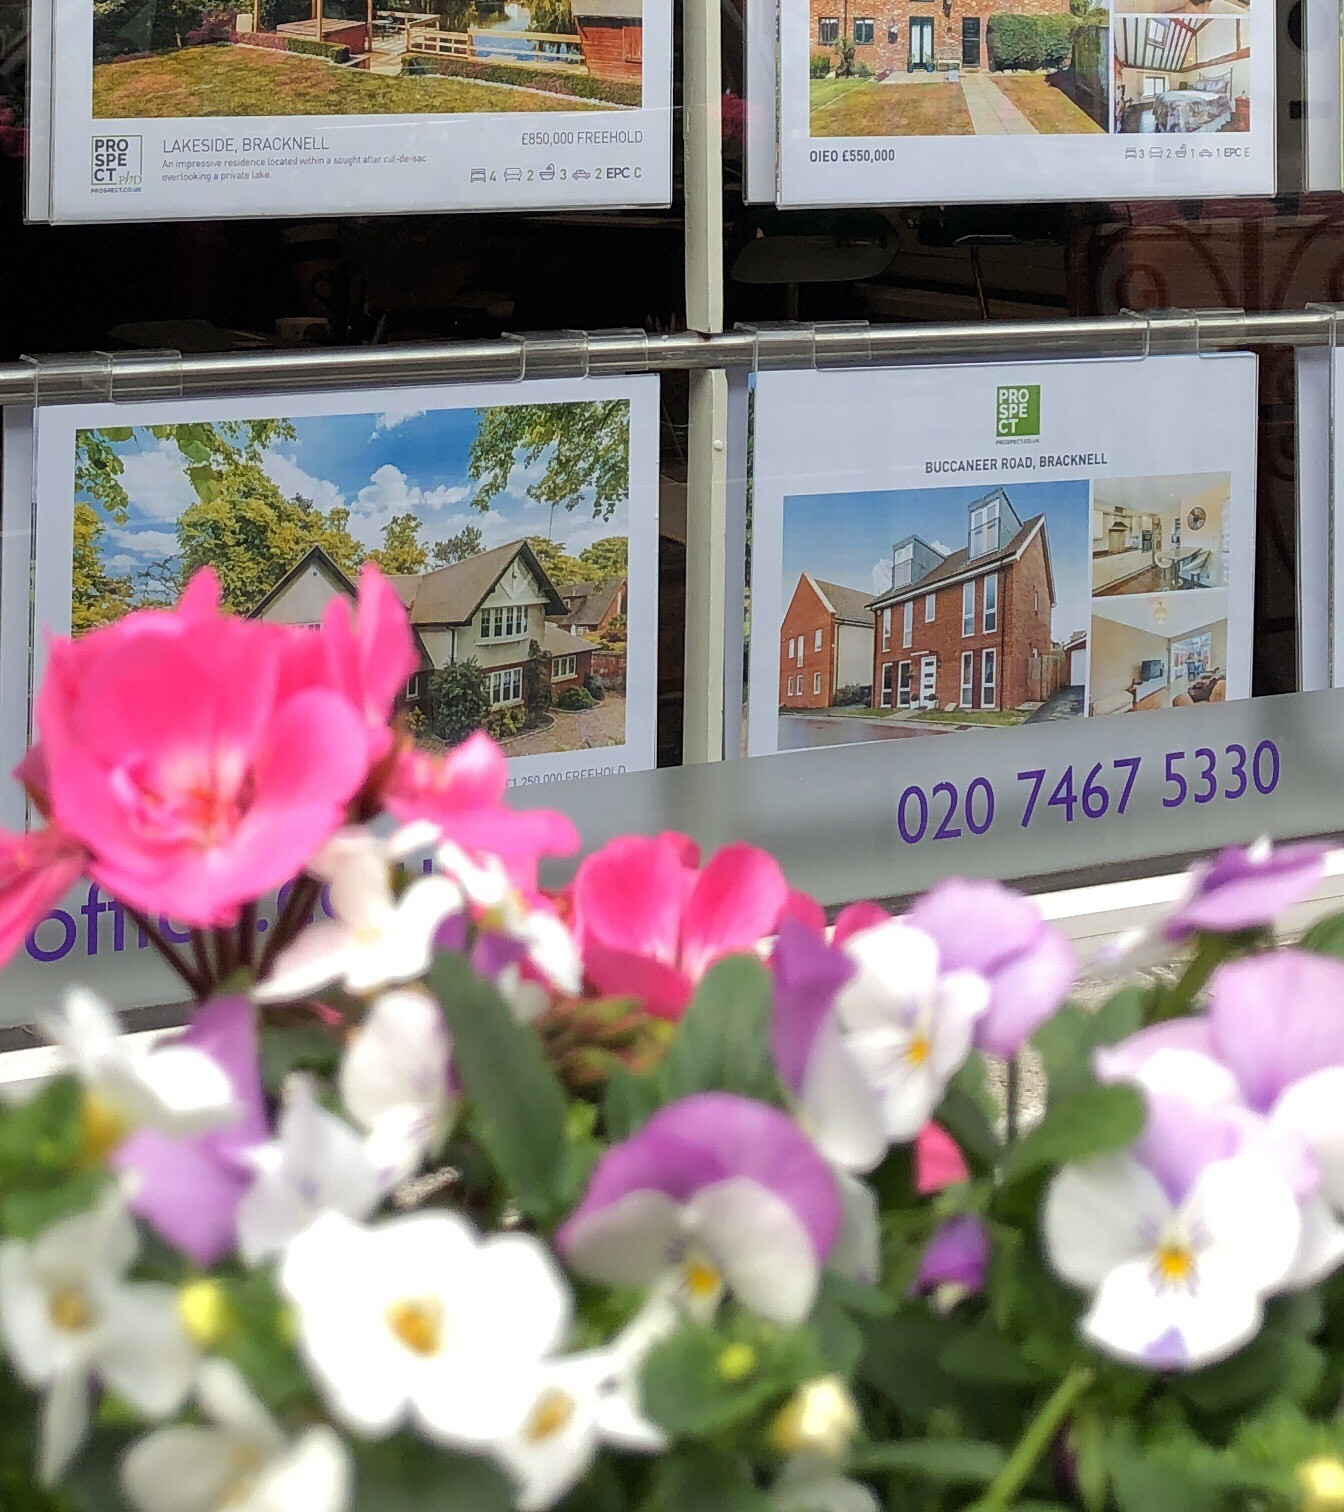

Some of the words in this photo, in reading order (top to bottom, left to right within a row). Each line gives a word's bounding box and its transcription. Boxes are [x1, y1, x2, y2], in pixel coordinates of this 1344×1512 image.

[95, 139, 129, 152] PRO
[163, 138, 237, 154] LAKESIDE,
[242, 136, 329, 151] BRACKNELL
[522, 132, 574, 146] £850,000
[577, 130, 642, 144] FREEHOLD
[95, 153, 127, 167] SPE
[810, 150, 838, 162] OIEO
[842, 149, 895, 163] £550,000
[1224, 148, 1241, 157] EPC
[161, 159, 173, 168] An
[176, 158, 221, 169] impressive
[224, 157, 265, 167] residence
[267, 156, 297, 166] located
[299, 156, 324, 165] within
[334, 155, 361, 167] sought
[362, 155, 381, 164] after
[383, 153, 427, 163] cul-de-sac
[94, 168, 116, 181] CT
[161, 171, 211, 183] overlooking
[220, 171, 250, 182] private
[489, 171, 497, 182] 4
[527, 170, 533, 181] 2
[560, 169, 567, 180] 3
[595, 168, 602, 179] 2
[606, 167, 630, 178] EPC
[634, 167, 642, 178] C
[999, 388, 1029, 404] PRO
[999, 403, 1028, 418] SPE
[998, 418, 1018, 434] CT
[925, 458, 998, 474] BUCCANEER
[1001, 457, 1036, 470] ROAD,
[1040, 453, 1108, 468] BRACKNELL
[898, 777, 994, 844] 020
[1017, 757, 1141, 829] 7467
[1162, 739, 1280, 808] 5330
